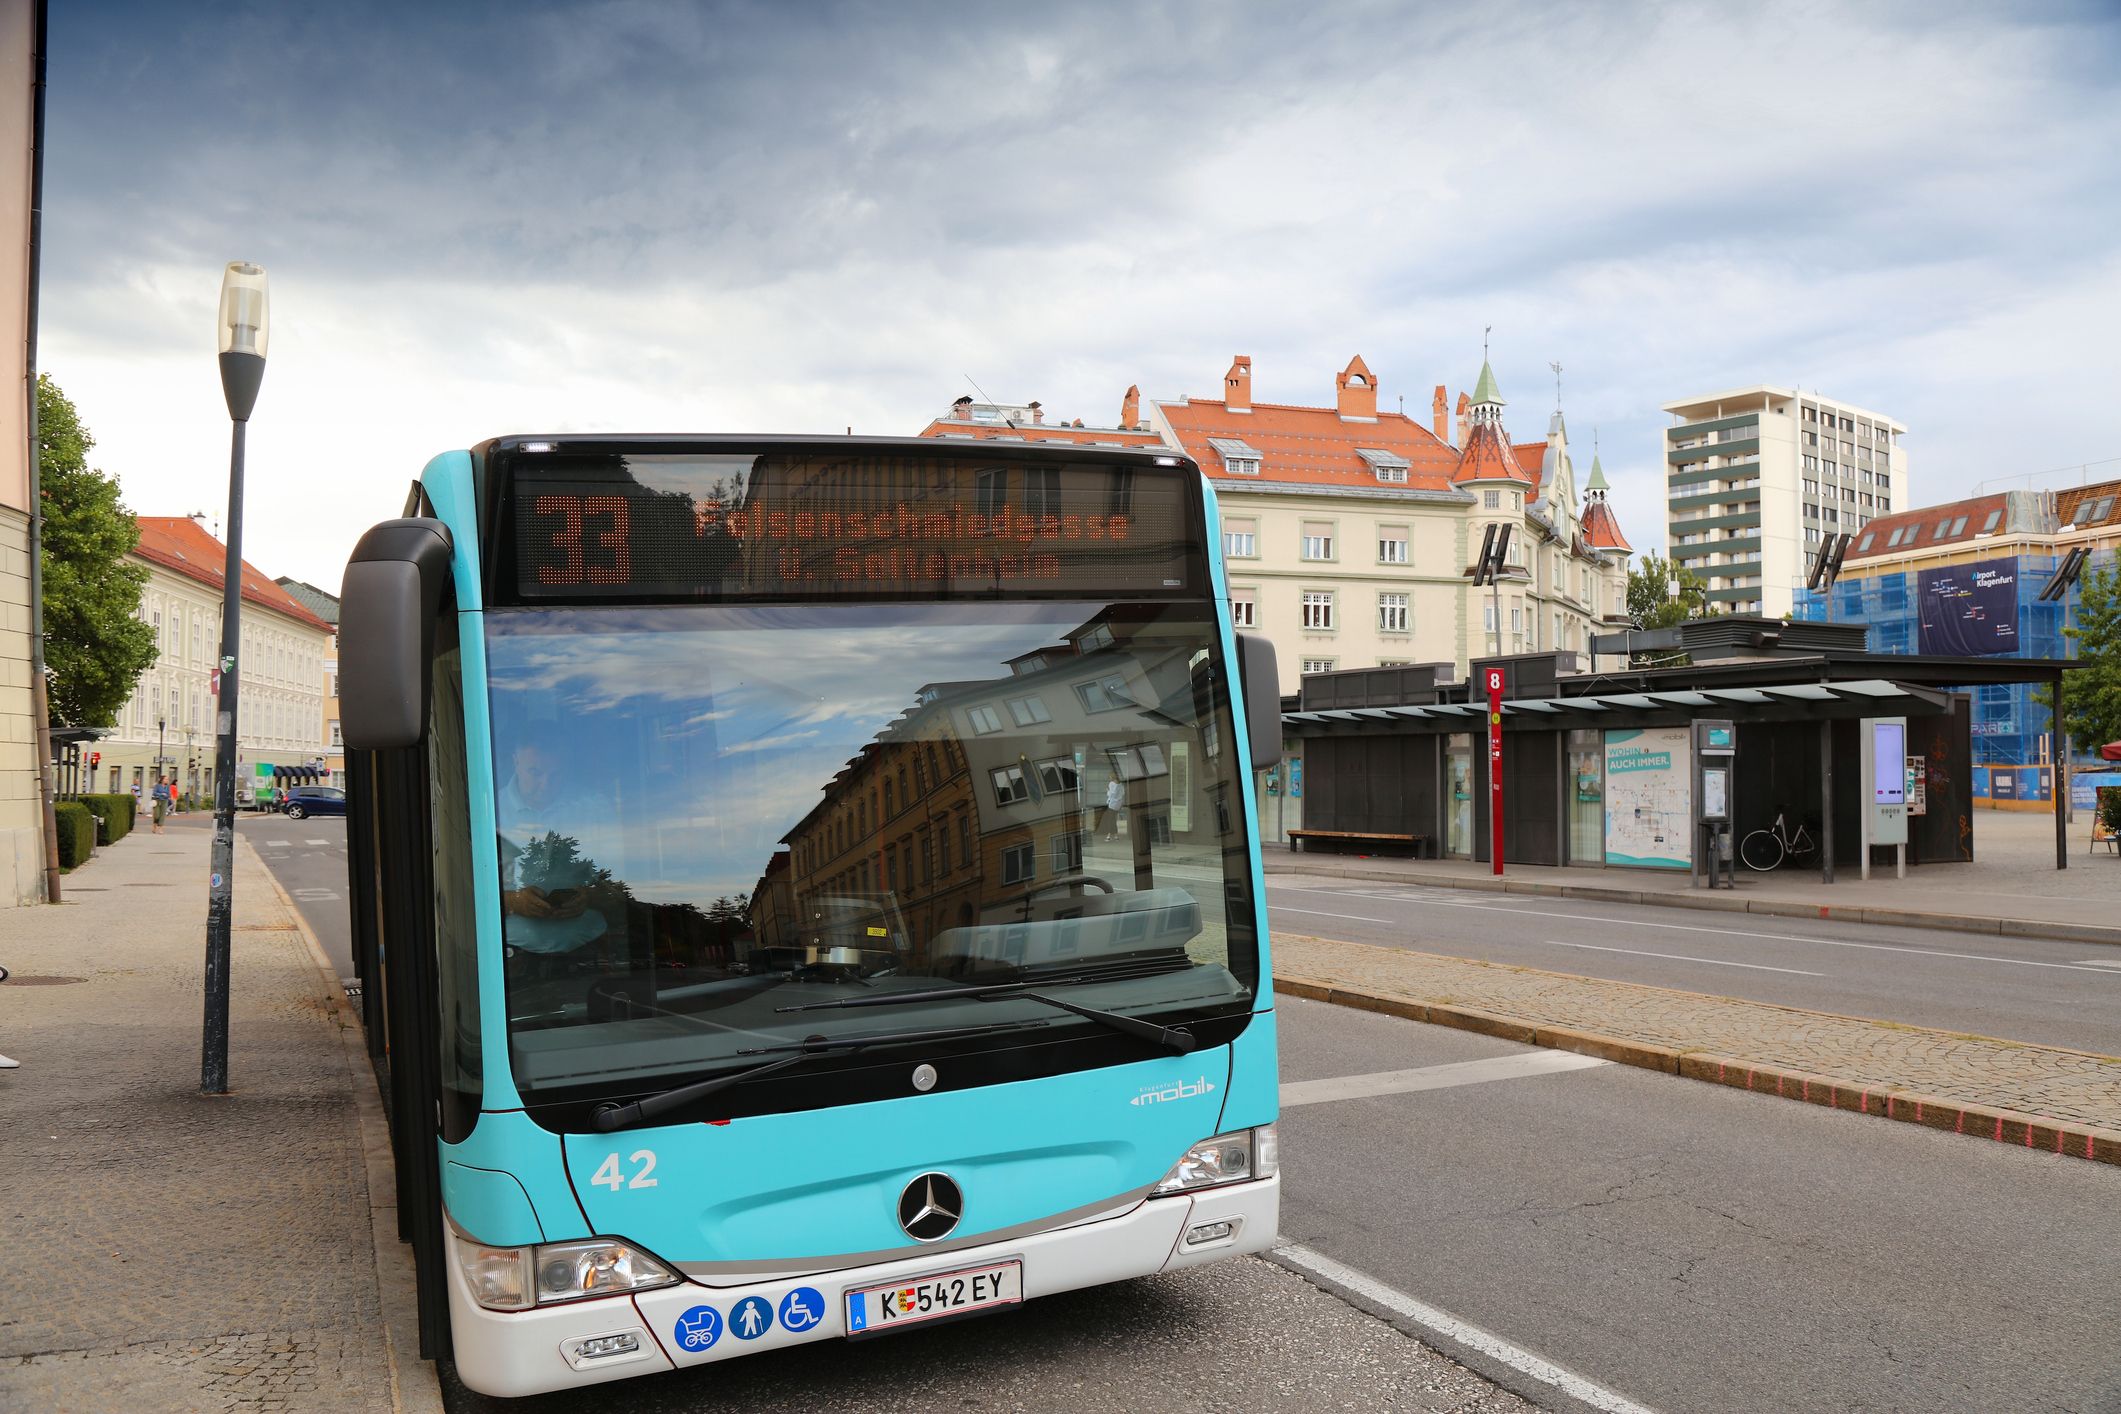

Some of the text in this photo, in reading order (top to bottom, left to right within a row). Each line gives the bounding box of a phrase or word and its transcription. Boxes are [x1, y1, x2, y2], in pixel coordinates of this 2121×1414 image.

[694, 500, 1128, 541] Felsenschmiedgasse
[536, 495, 630, 584] 33
[835, 547, 1060, 579] Seltenheim
[1972, 570, 1996, 580] Airport
[1976, 576, 2013, 587] Klagenfurt
[1490, 673, 1501, 690] 8
[1970, 724, 1999, 734] PAR
[1608, 747, 1641, 756] WOHIN
[1610, 756, 1669, 769] AUCH IMMER.
[1141, 1076, 1205, 1105] mobil
[590, 1149, 658, 1192] 42
[881, 1291, 897, 1320] K
[855, 1316, 863, 1325] A
